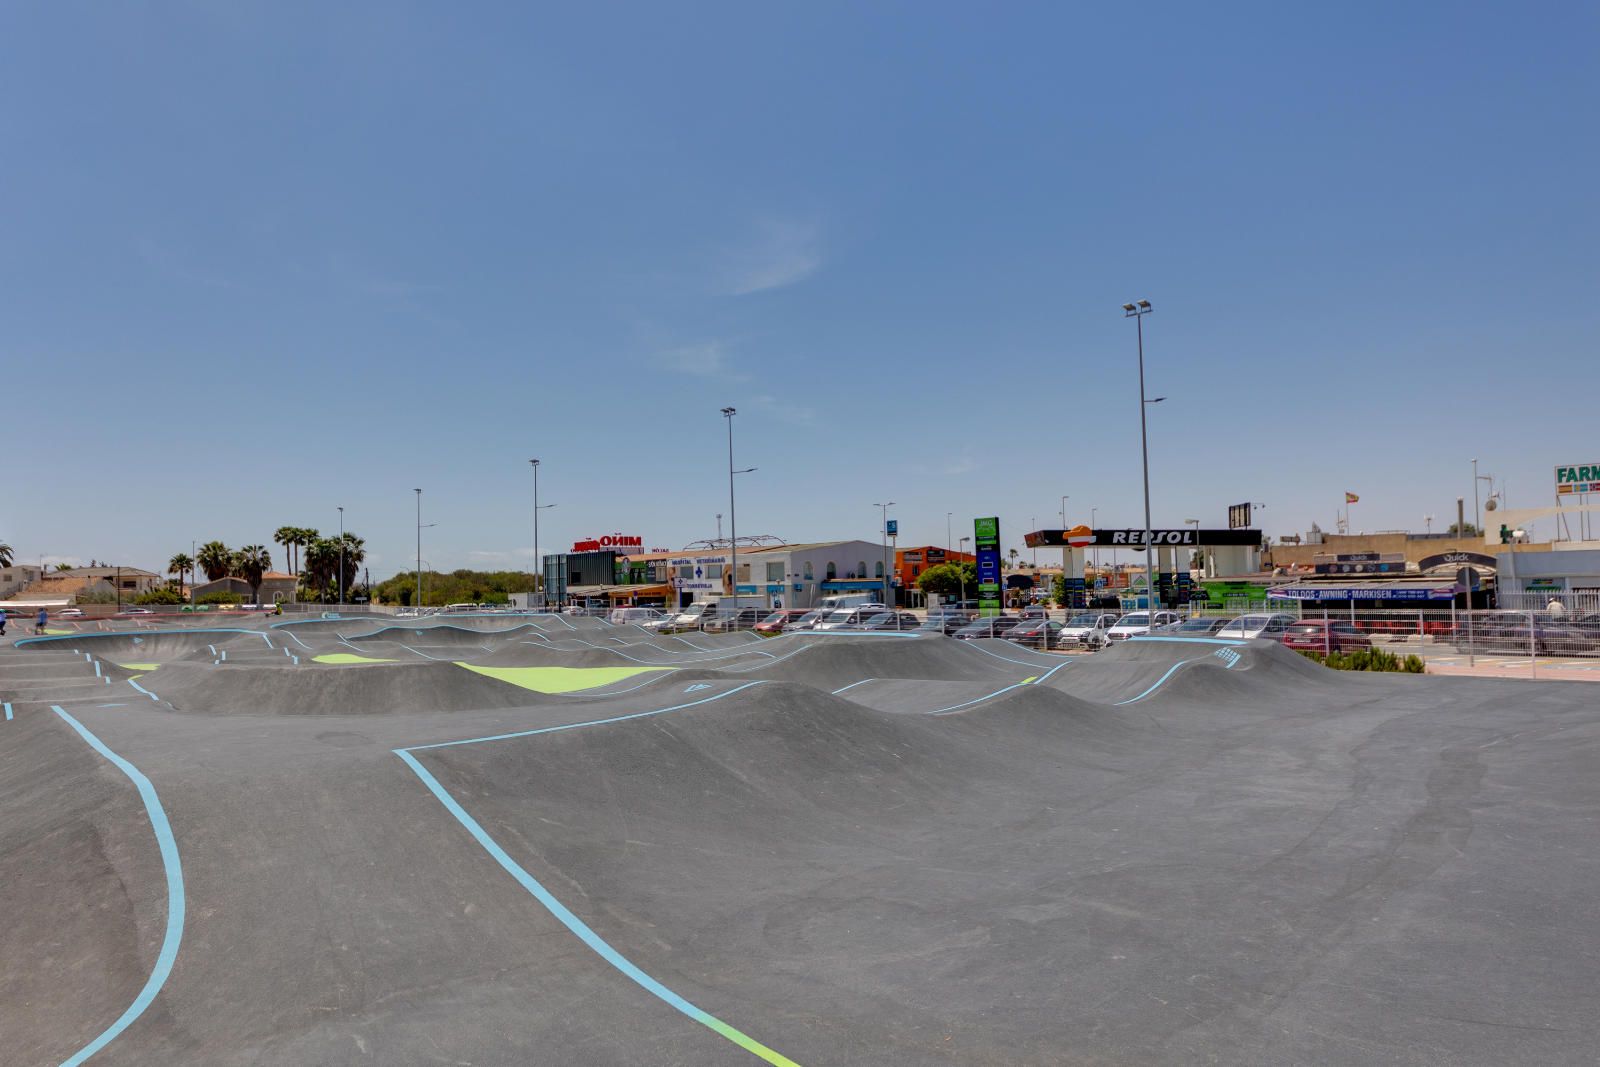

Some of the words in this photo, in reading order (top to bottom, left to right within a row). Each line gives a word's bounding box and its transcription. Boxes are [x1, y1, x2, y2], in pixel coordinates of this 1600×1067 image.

[1112, 531, 1192, 544] REPSOL
[1443, 553, 1469, 562] Quick
[1288, 590, 1315, 599] TOLDOS
[1318, 590, 1347, 599] AWNING
[1352, 590, 1391, 599] MARKISEN
